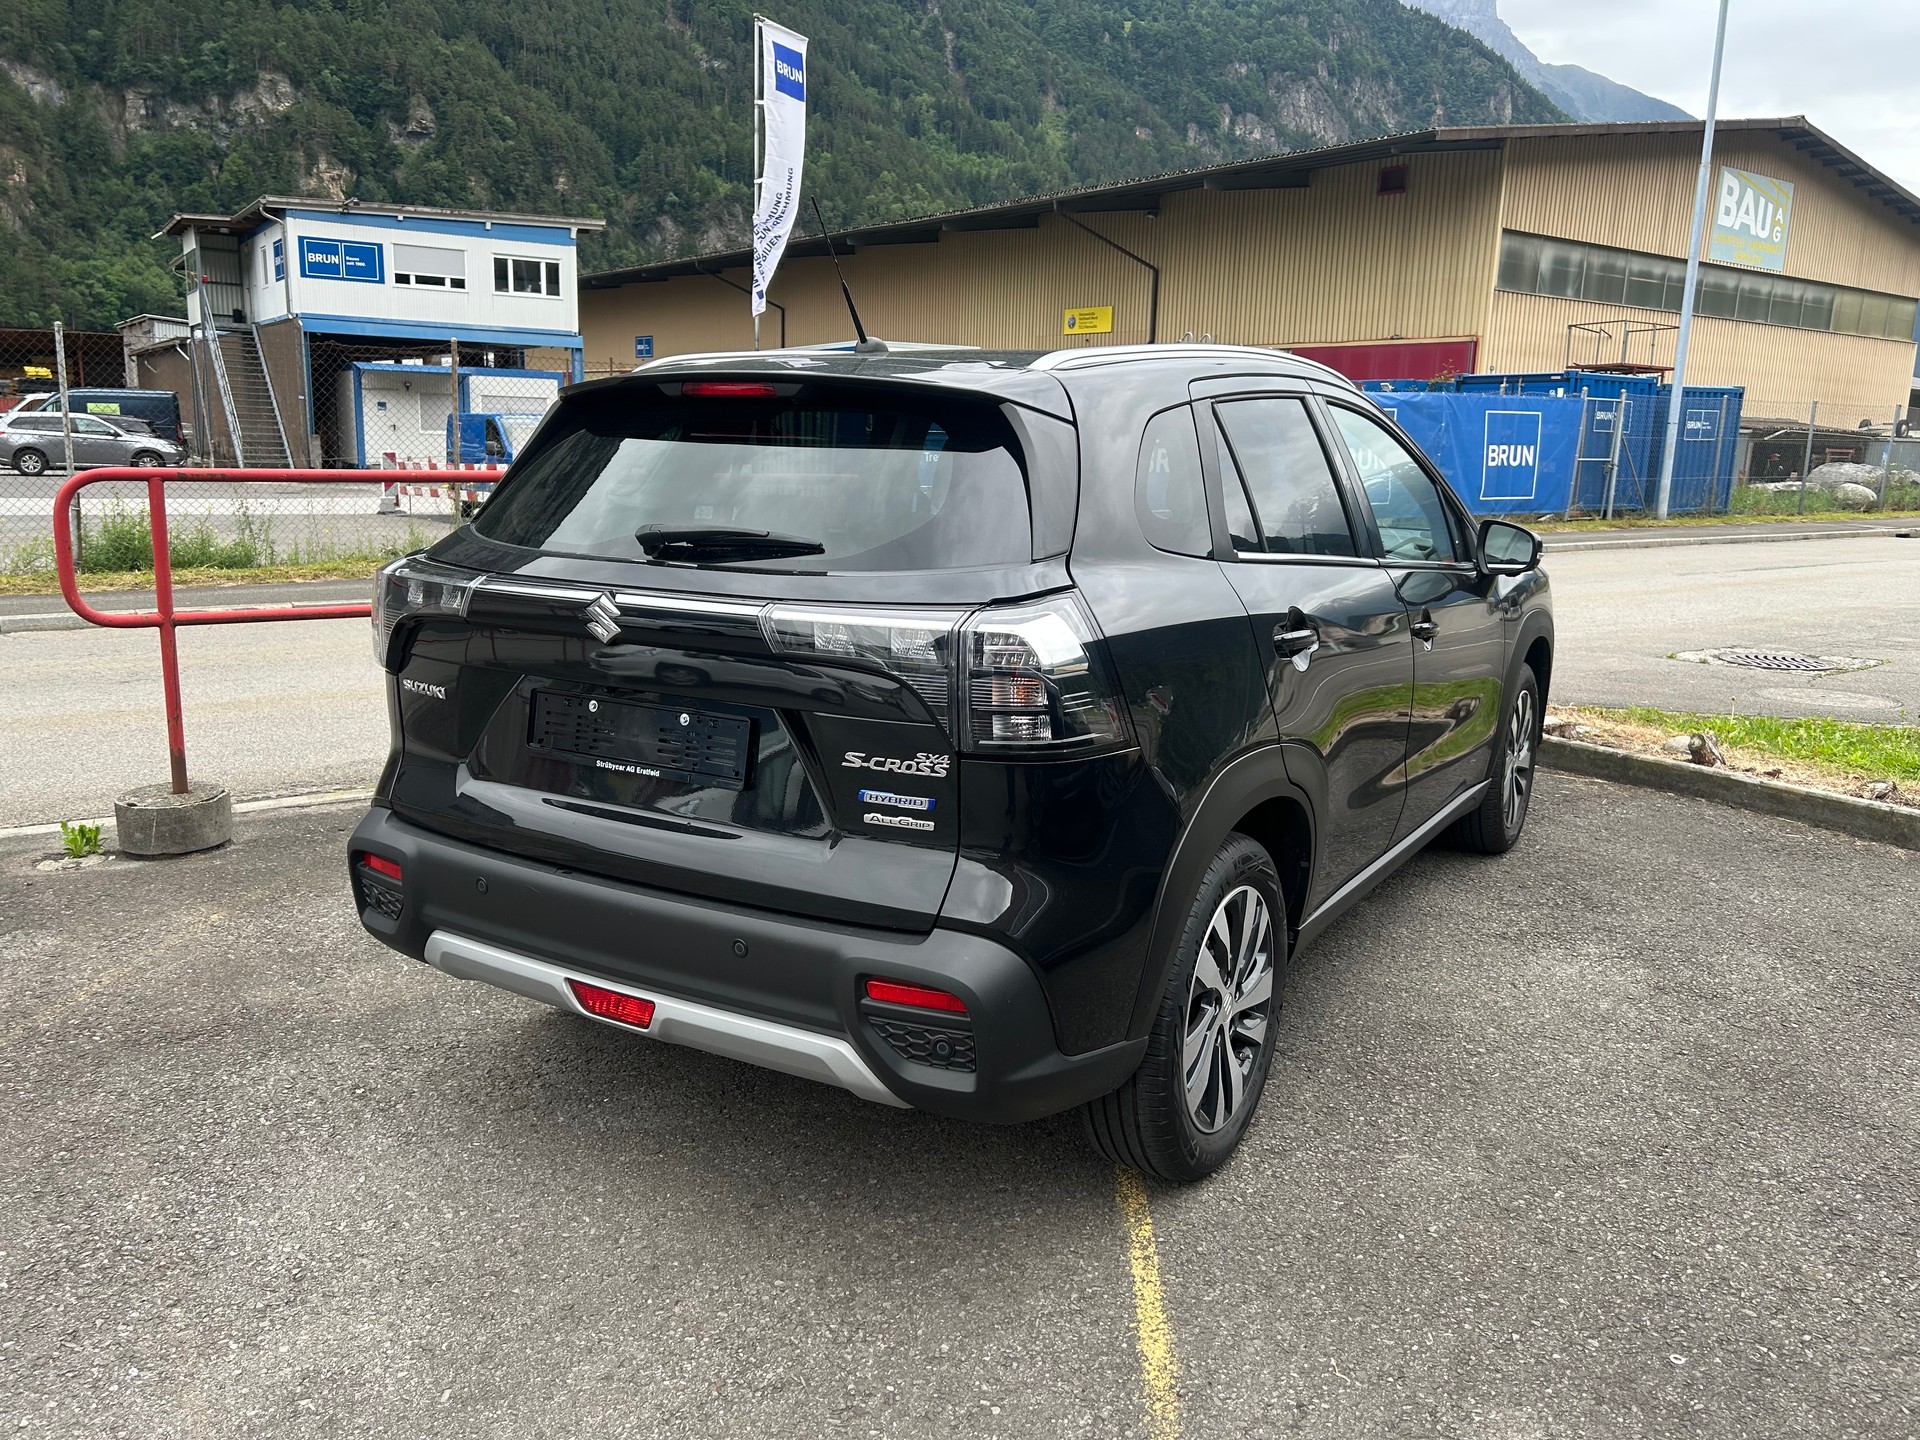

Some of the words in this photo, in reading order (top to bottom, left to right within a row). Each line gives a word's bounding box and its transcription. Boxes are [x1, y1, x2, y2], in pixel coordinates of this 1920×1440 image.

[777, 59, 803, 84] BRUN
[1717, 170, 1774, 239] BAU
[307, 252, 340, 265] BRUN
[1487, 444, 1535, 467] BRUN
[402, 678, 447, 700] SUZUKI
[626, 765, 636, 773] AG
[841, 751, 950, 778] S-CROSS
[913, 752, 951, 767] SX4
[868, 793, 924, 807] HYBRID
